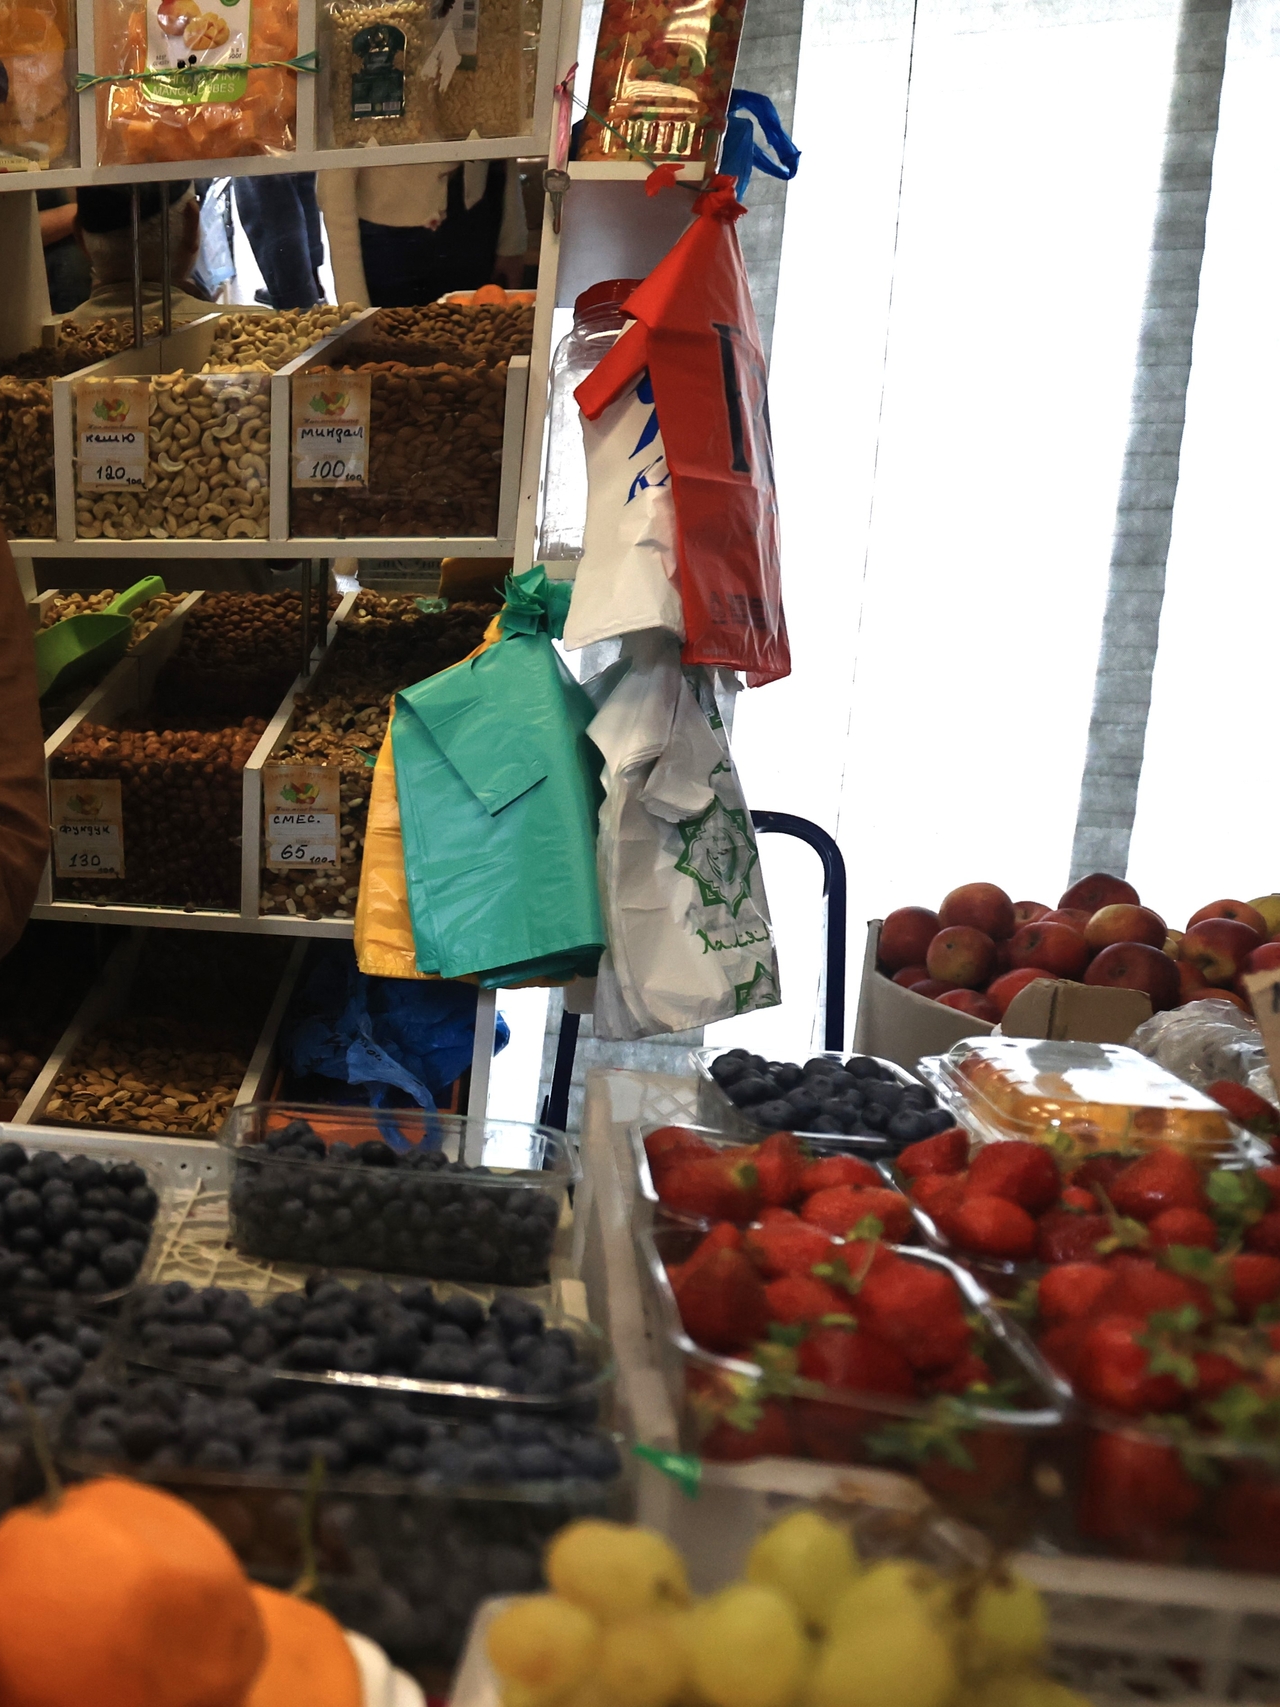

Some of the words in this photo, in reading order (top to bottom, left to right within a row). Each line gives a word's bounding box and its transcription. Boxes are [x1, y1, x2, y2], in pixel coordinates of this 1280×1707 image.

[96, 465, 126, 480] 120
[310, 460, 345, 479] 100
[59, 824, 110, 836] фундук
[280, 844, 308, 860] 65
[69, 853, 101, 868] 130
